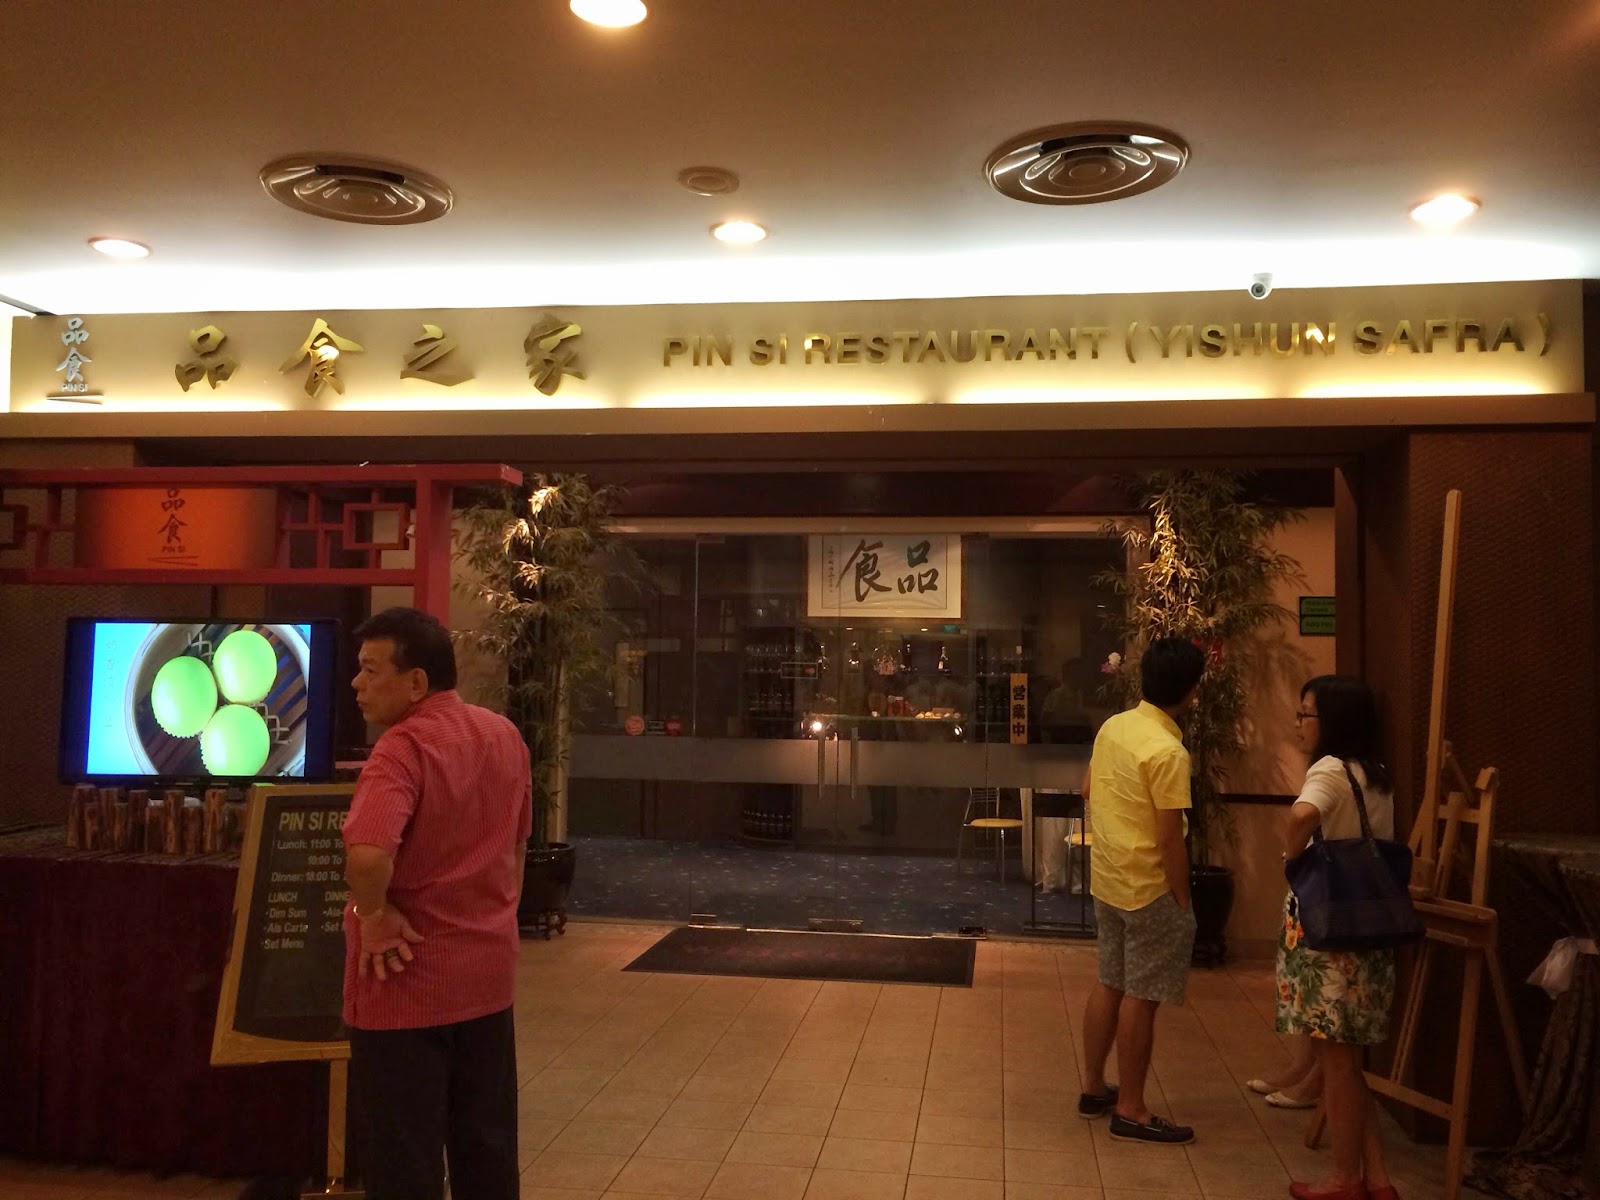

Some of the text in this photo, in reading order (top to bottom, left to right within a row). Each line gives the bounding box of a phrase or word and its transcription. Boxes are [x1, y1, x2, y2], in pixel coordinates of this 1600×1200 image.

[57, 317, 92, 382] 品食
[663, 335, 732, 367] PIN
[749, 333, 787, 366] SI
[804, 327, 1109, 365] RESTAURANT
[175, 313, 587, 396] 品食之家
[62, 383, 88, 392] PIN SI
[279, 811, 305, 831] PIN
[308, 811, 325, 831] SI
[334, 839, 344, 848] To
[332, 855, 342, 865] To
[271, 871, 304, 882] Dinner:
[330, 871, 340, 881] To
[268, 891, 298, 903] LUNCH
[324, 891, 351, 901] DINNE
[269, 907, 307, 919] Dim Sum
[284, 922, 309, 933] Carte
[324, 922, 339, 932] Set
[264, 938, 304, 950] Set Menu
